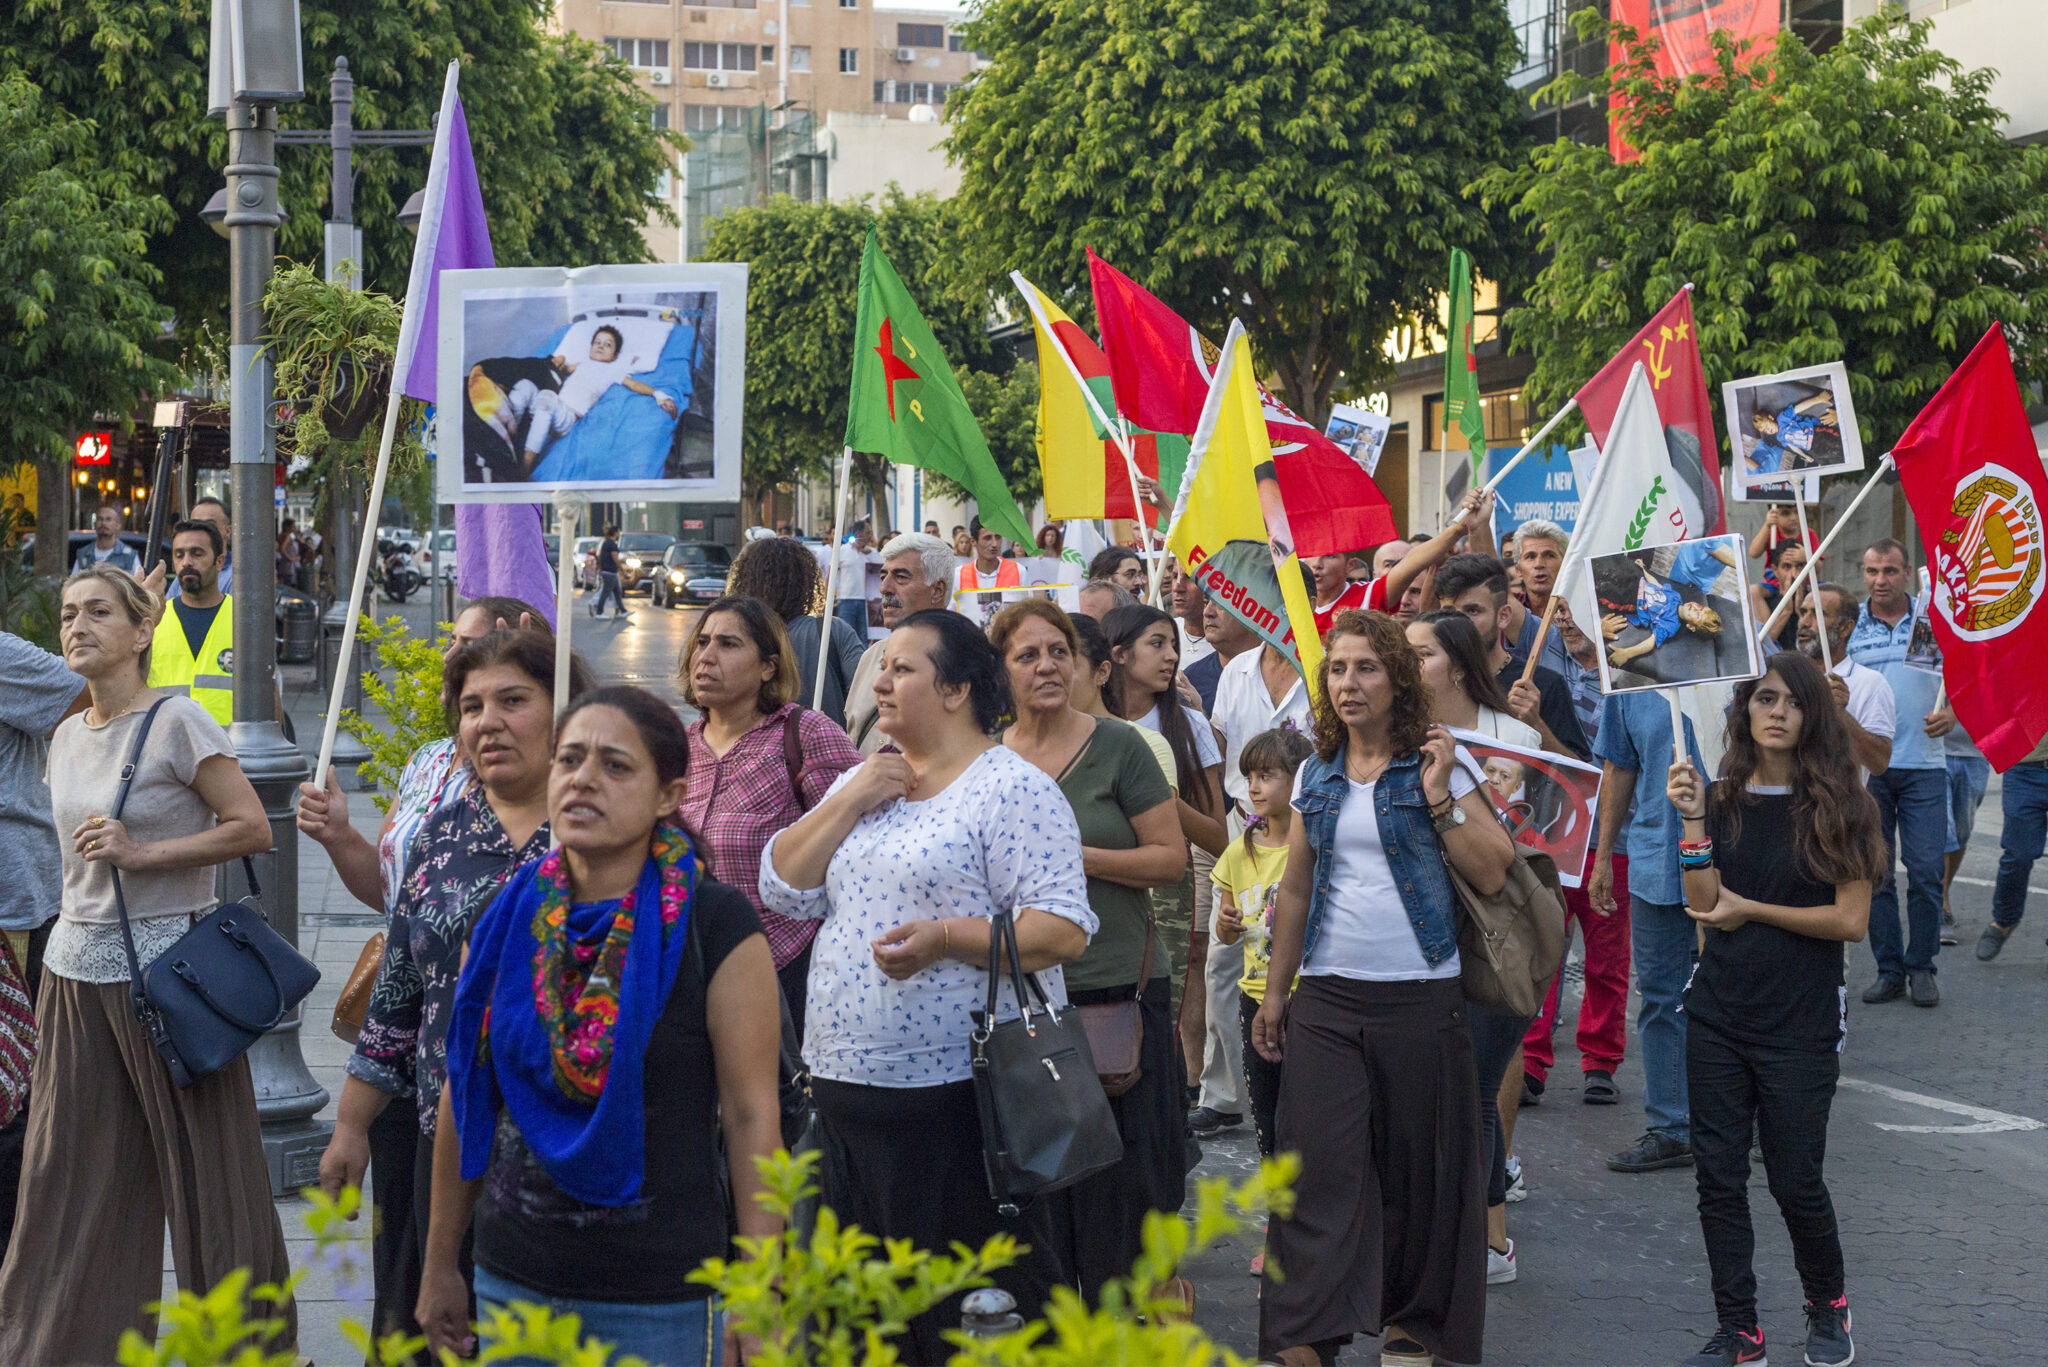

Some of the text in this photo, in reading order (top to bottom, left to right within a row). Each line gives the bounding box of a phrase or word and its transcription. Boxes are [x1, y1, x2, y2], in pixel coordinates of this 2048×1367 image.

[1544, 472, 1574, 491] A NEW
[1513, 502, 1553, 521] SHOPPING
[1188, 544, 1280, 635] Freedom
